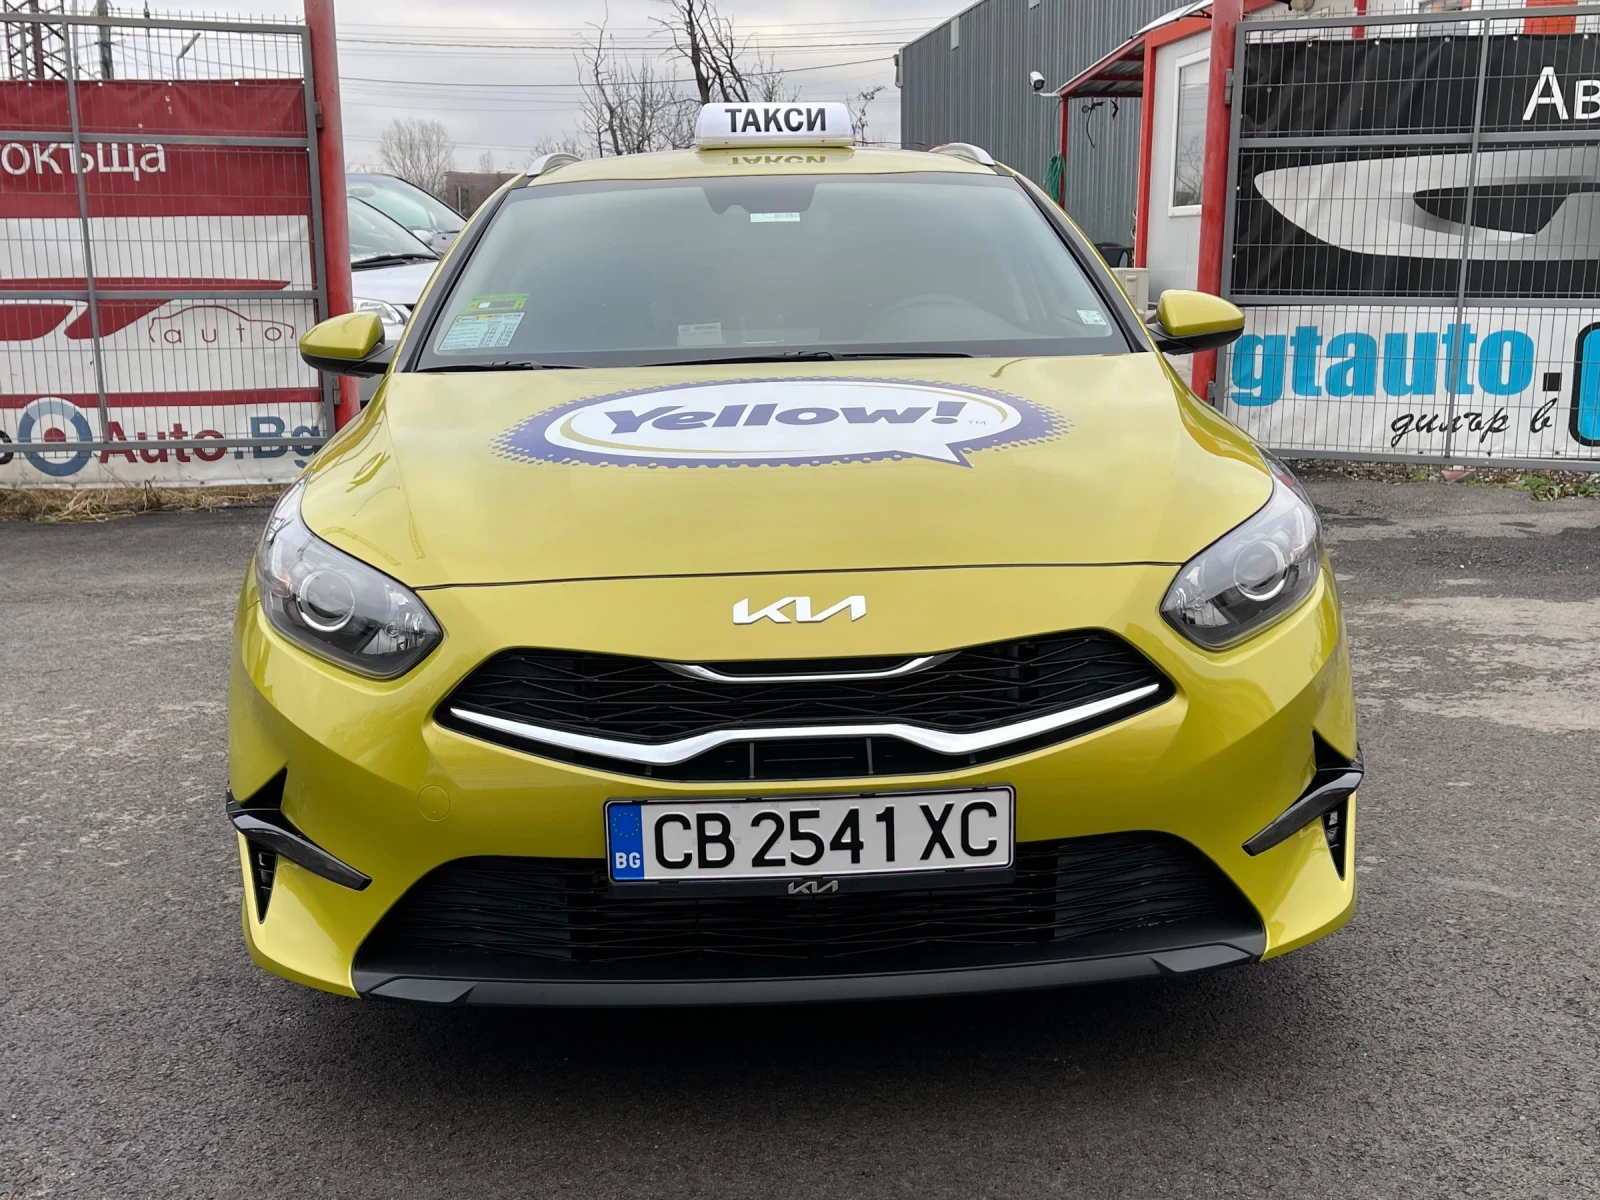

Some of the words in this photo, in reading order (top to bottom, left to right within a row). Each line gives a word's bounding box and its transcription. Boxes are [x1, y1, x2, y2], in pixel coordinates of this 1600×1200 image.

[725, 108, 826, 132] ТАКСИ
[0, 143, 166, 181] окъща
[164, 324, 282, 343] auto
[603, 401, 967, 434] Yellow!
[1391, 406, 1509, 448] дилър
[99, 416, 320, 468] Auto.Bg
[733, 594, 867, 625] KIA
[653, 811, 736, 869] CB
[750, 805, 896, 867] 2541
[919, 800, 998, 860] XC
[615, 852, 641, 869] BG
